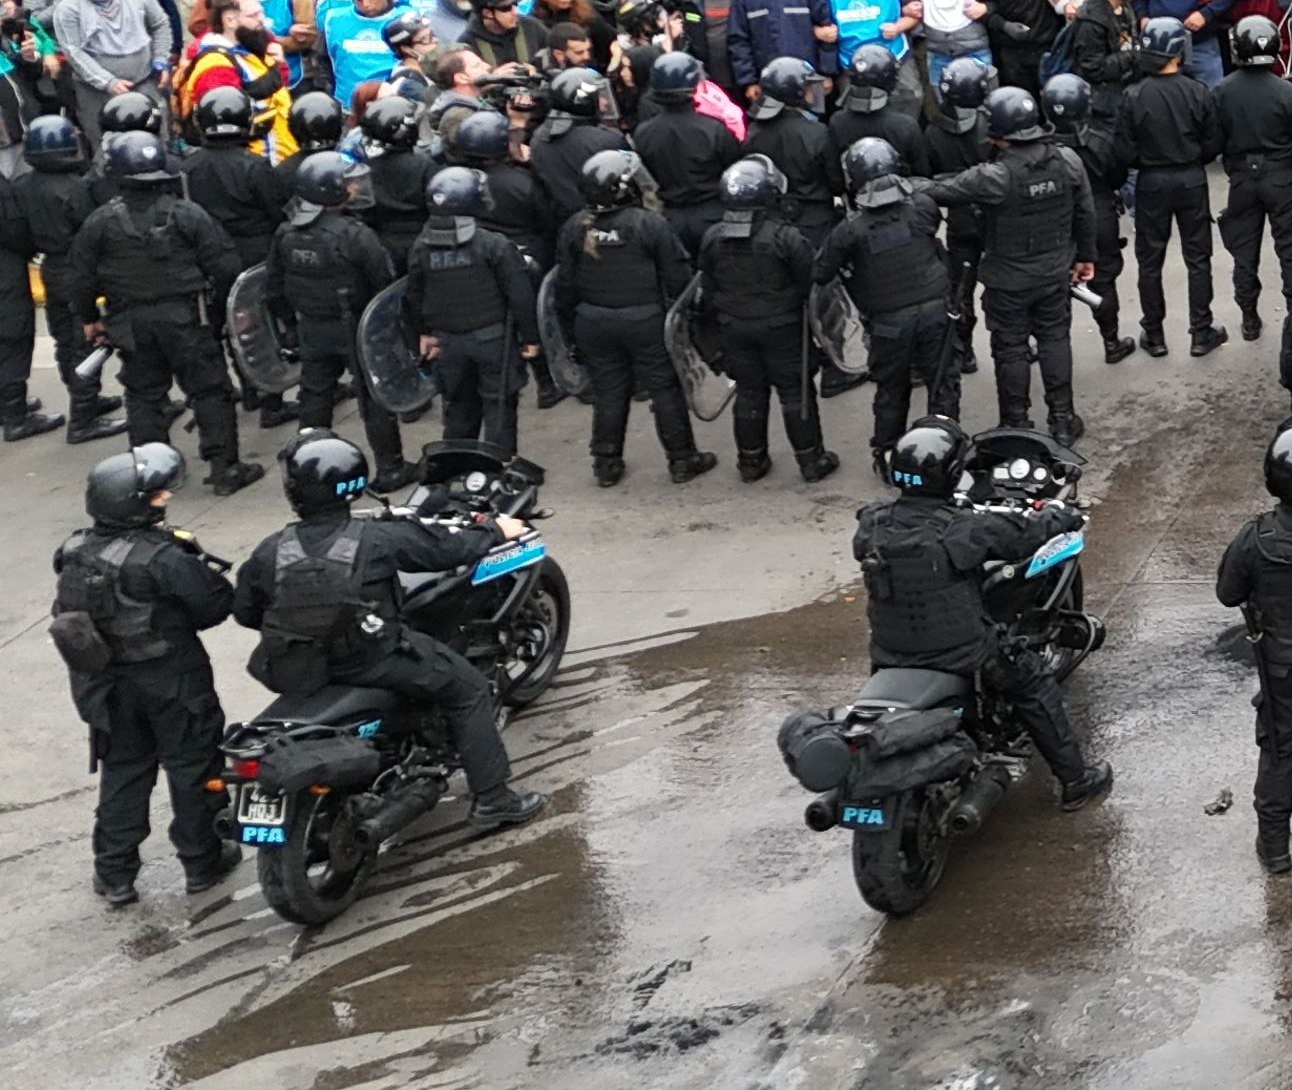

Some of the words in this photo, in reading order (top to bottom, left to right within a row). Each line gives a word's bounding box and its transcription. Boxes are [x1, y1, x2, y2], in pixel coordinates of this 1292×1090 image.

[1030, 181, 1056, 196] PFA
[337, 477, 365, 494] PFA
[894, 471, 923, 485] PFA
[843, 807, 885, 824] PFA
[243, 826, 286, 842] PFA
